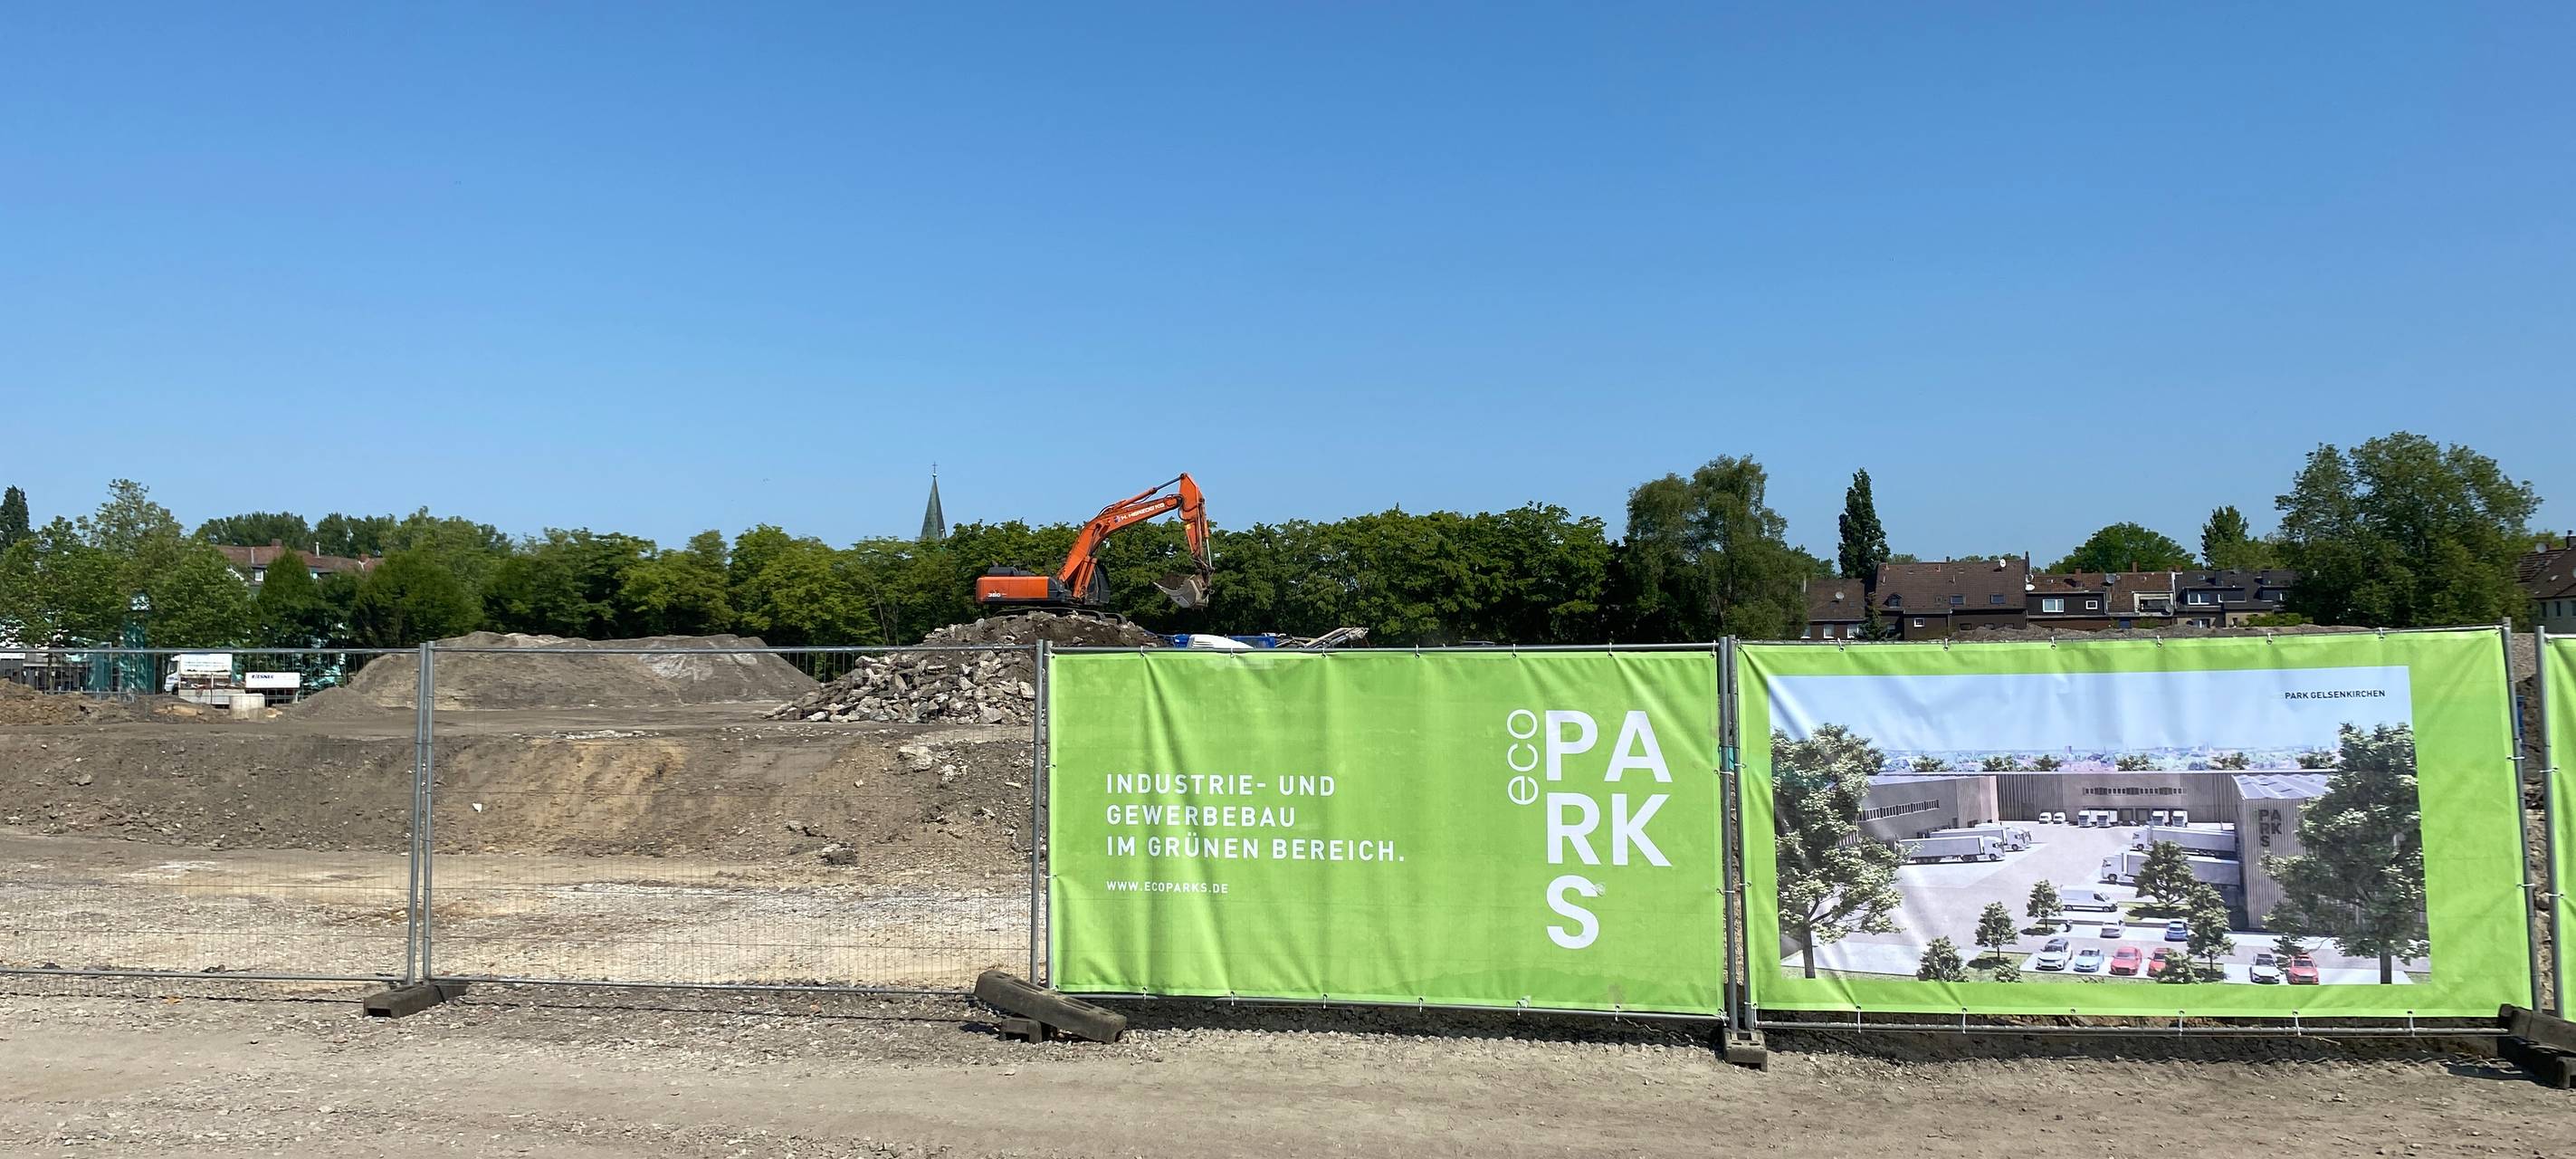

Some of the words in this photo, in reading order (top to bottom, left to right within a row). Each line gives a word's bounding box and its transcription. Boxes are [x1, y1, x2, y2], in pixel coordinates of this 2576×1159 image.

[2285, 692, 2309, 700] PARK
[2310, 689, 2386, 700] GELSENKIRCHEN
[1507, 709, 1539, 805] eco
[1106, 773, 1266, 796] INDUSTRIE-
[1278, 775, 1336, 797] UND
[1106, 804, 1296, 828] GEWERBEBAU
[1106, 836, 1136, 857] IM
[1148, 832, 1259, 859] GRÜNEN
[1272, 838, 1405, 862] BEREICH.
[1106, 880, 1229, 894] WWW.ECOPARKS.DE
